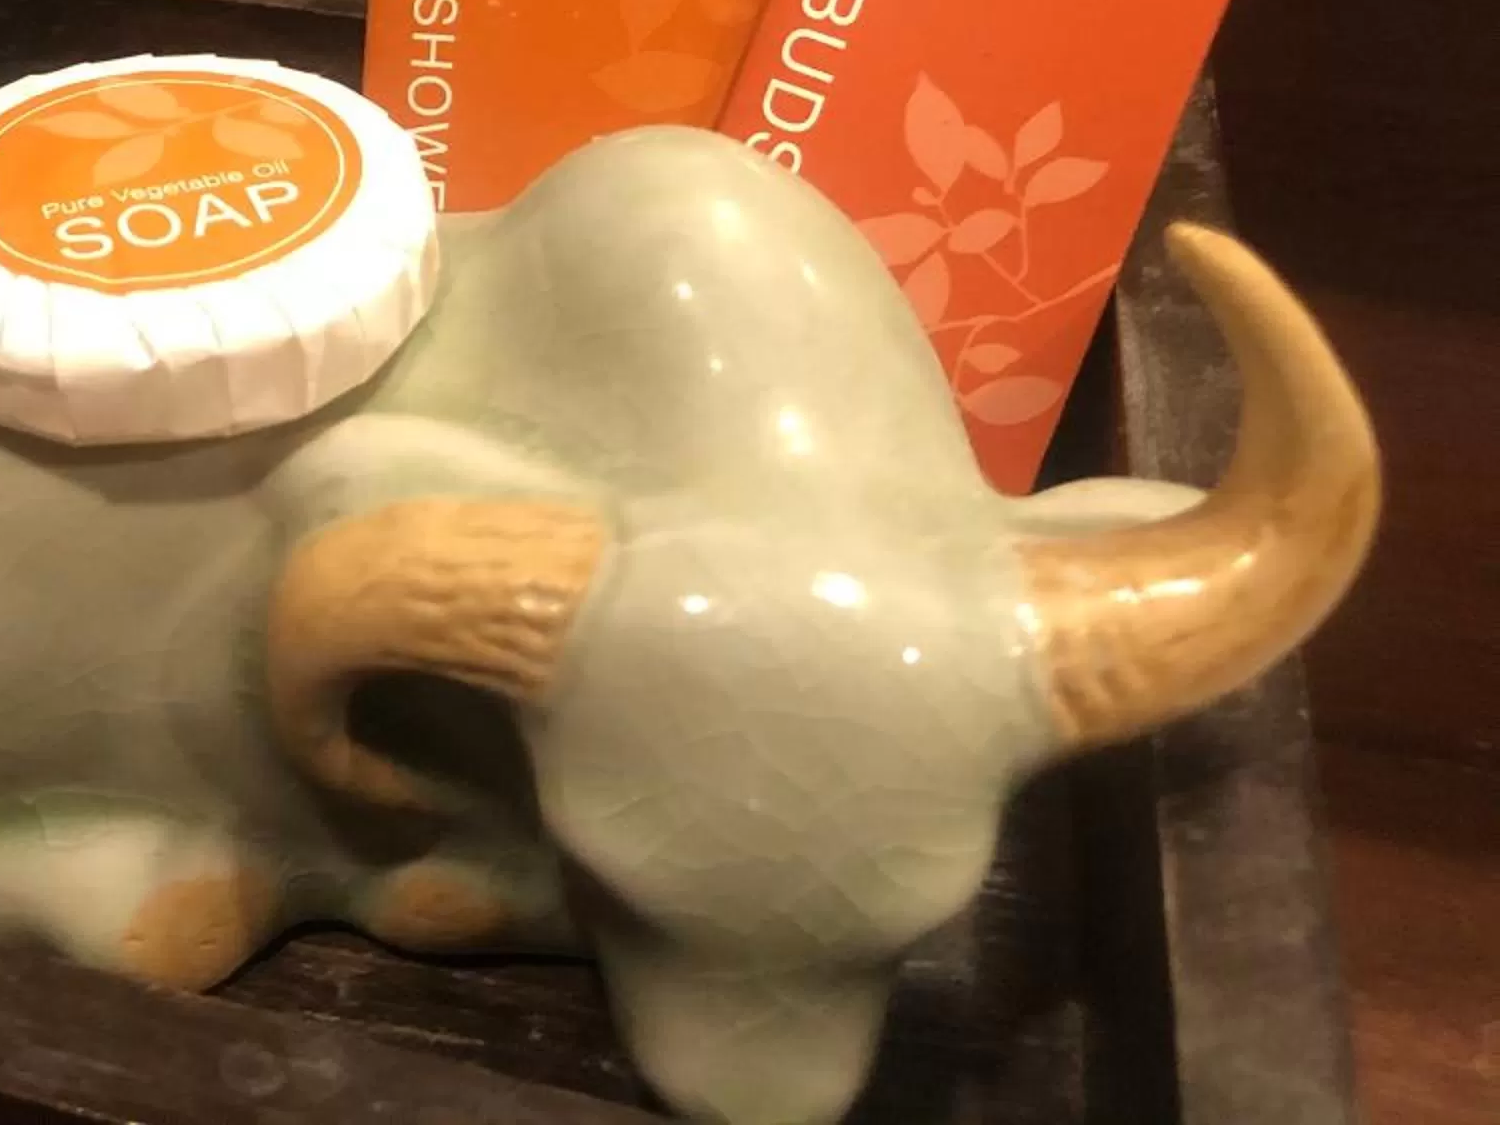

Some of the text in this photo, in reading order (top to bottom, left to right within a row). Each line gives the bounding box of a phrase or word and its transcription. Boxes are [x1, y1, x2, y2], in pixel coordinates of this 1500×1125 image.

[40, 158, 290, 221] Pure Vegetable Oil
[55, 180, 300, 260] SOAP
